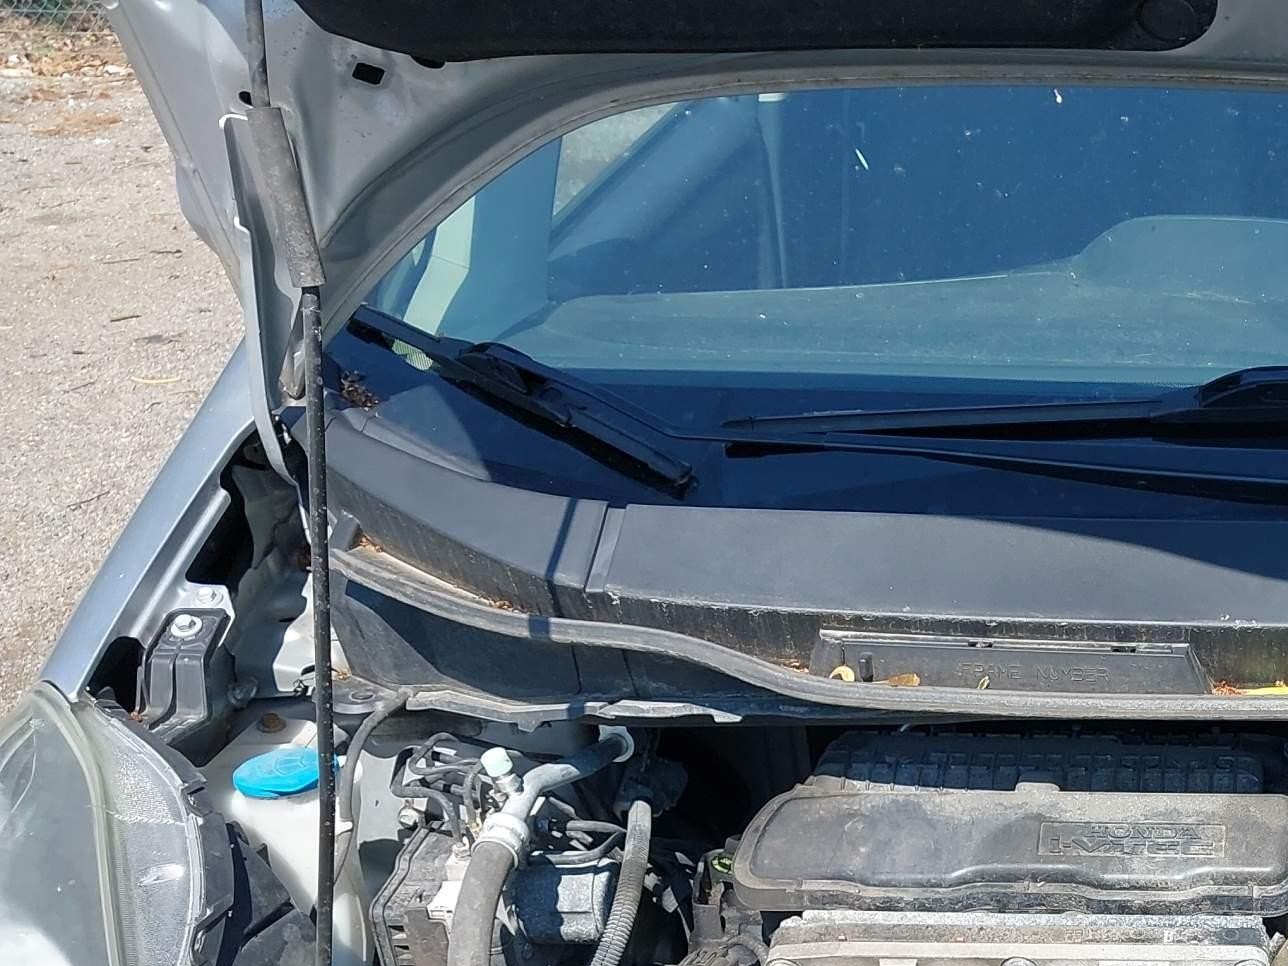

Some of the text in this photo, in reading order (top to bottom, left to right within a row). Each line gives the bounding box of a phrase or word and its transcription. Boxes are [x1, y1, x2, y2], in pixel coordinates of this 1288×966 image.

[958, 662, 1110, 684] FRAME NUMBER
[1083, 824, 1202, 840] HONDA
